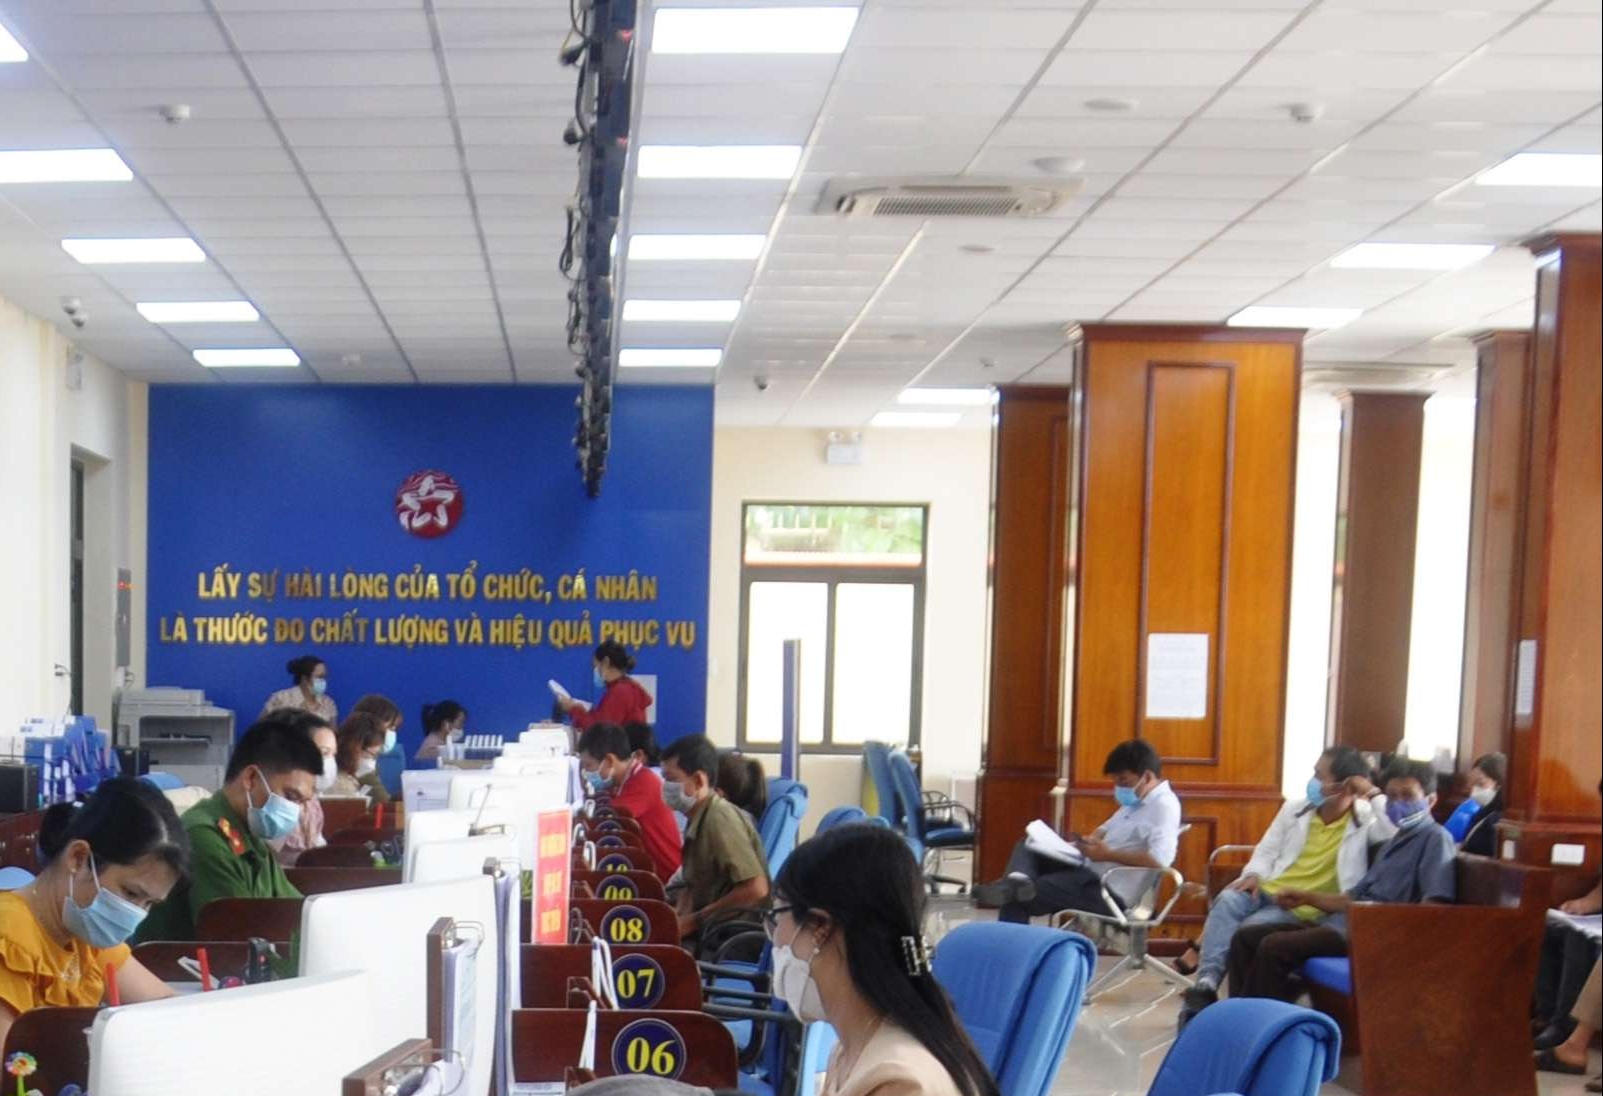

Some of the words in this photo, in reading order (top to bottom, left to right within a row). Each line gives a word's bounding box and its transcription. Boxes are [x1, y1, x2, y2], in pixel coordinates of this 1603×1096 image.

[198, 563, 242, 598] LẤY
[248, 568, 279, 603] SỰ
[285, 566, 323, 598] HÀI
[330, 566, 389, 598] LÒNG
[395, 563, 440, 599] CỦA
[446, 560, 478, 599] TỔ
[483, 568, 552, 604] CHỨC,
[558, 568, 587, 600] CÁ
[595, 569, 657, 600] NHÂN
[160, 611, 188, 642] LÀ
[193, 610, 268, 643] THƯỚC
[310, 608, 370, 642] CHẤT
[374, 613, 448, 651] LƯỢNG
[454, 611, 484, 644] VÀ
[489, 613, 543, 650] HIỆU
[548, 609, 593, 648] QUẢ
[600, 619, 660, 651] PHỤC
[610, 917, 644, 942] 08
[616, 968, 656, 998] 07
[626, 1036, 677, 1075] 06
